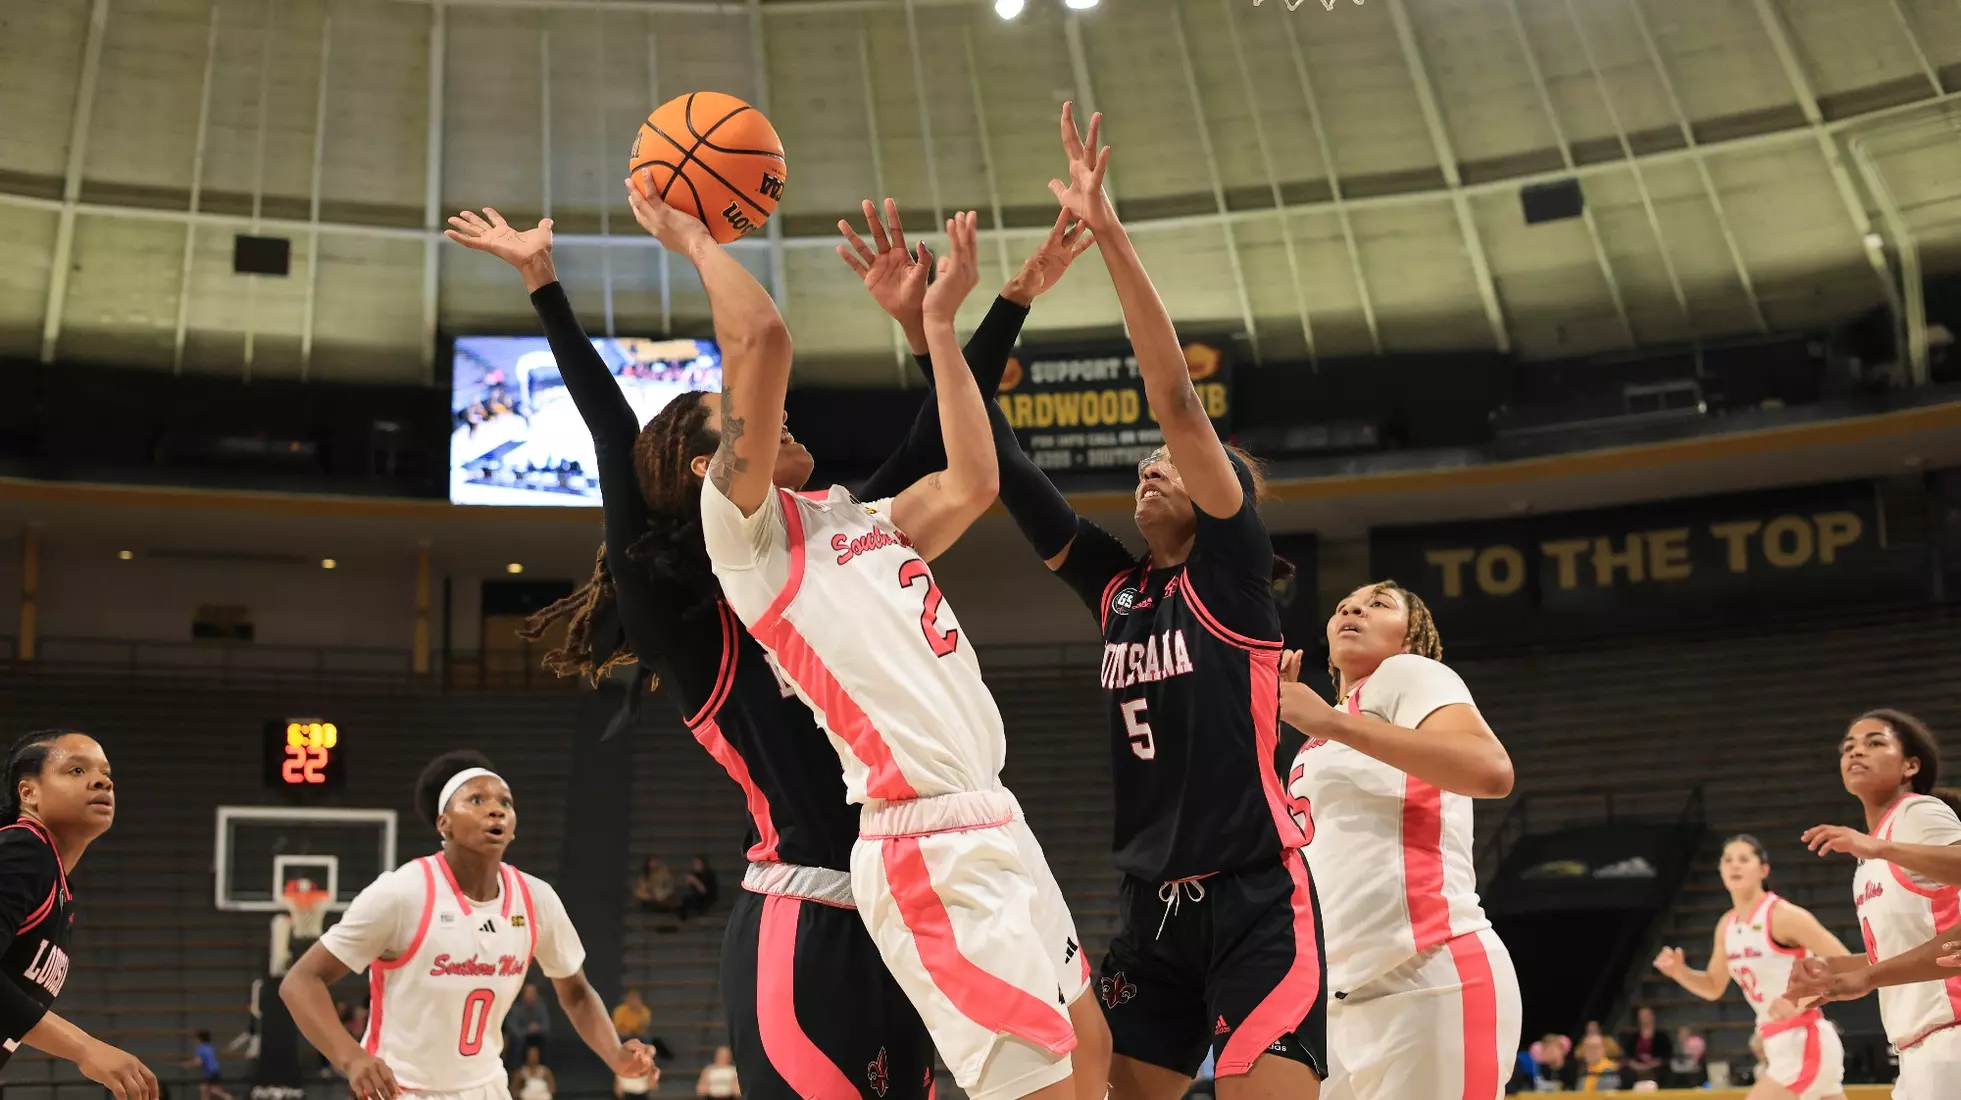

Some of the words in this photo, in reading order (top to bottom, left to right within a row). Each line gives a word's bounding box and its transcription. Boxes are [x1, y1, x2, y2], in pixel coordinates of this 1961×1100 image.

[722, 200, 758, 235] son
[1030, 357, 1120, 383] SUPPORT
[999, 389, 1139, 428] ARDWOOD
[1425, 545, 1526, 598] TO
[1540, 528, 1693, 590] THE
[1710, 512, 1862, 574] TOP
[899, 558, 958, 658] 2
[1120, 698, 1156, 760] 5
[282, 745, 328, 783] 22
[459, 988, 495, 1057] 0
